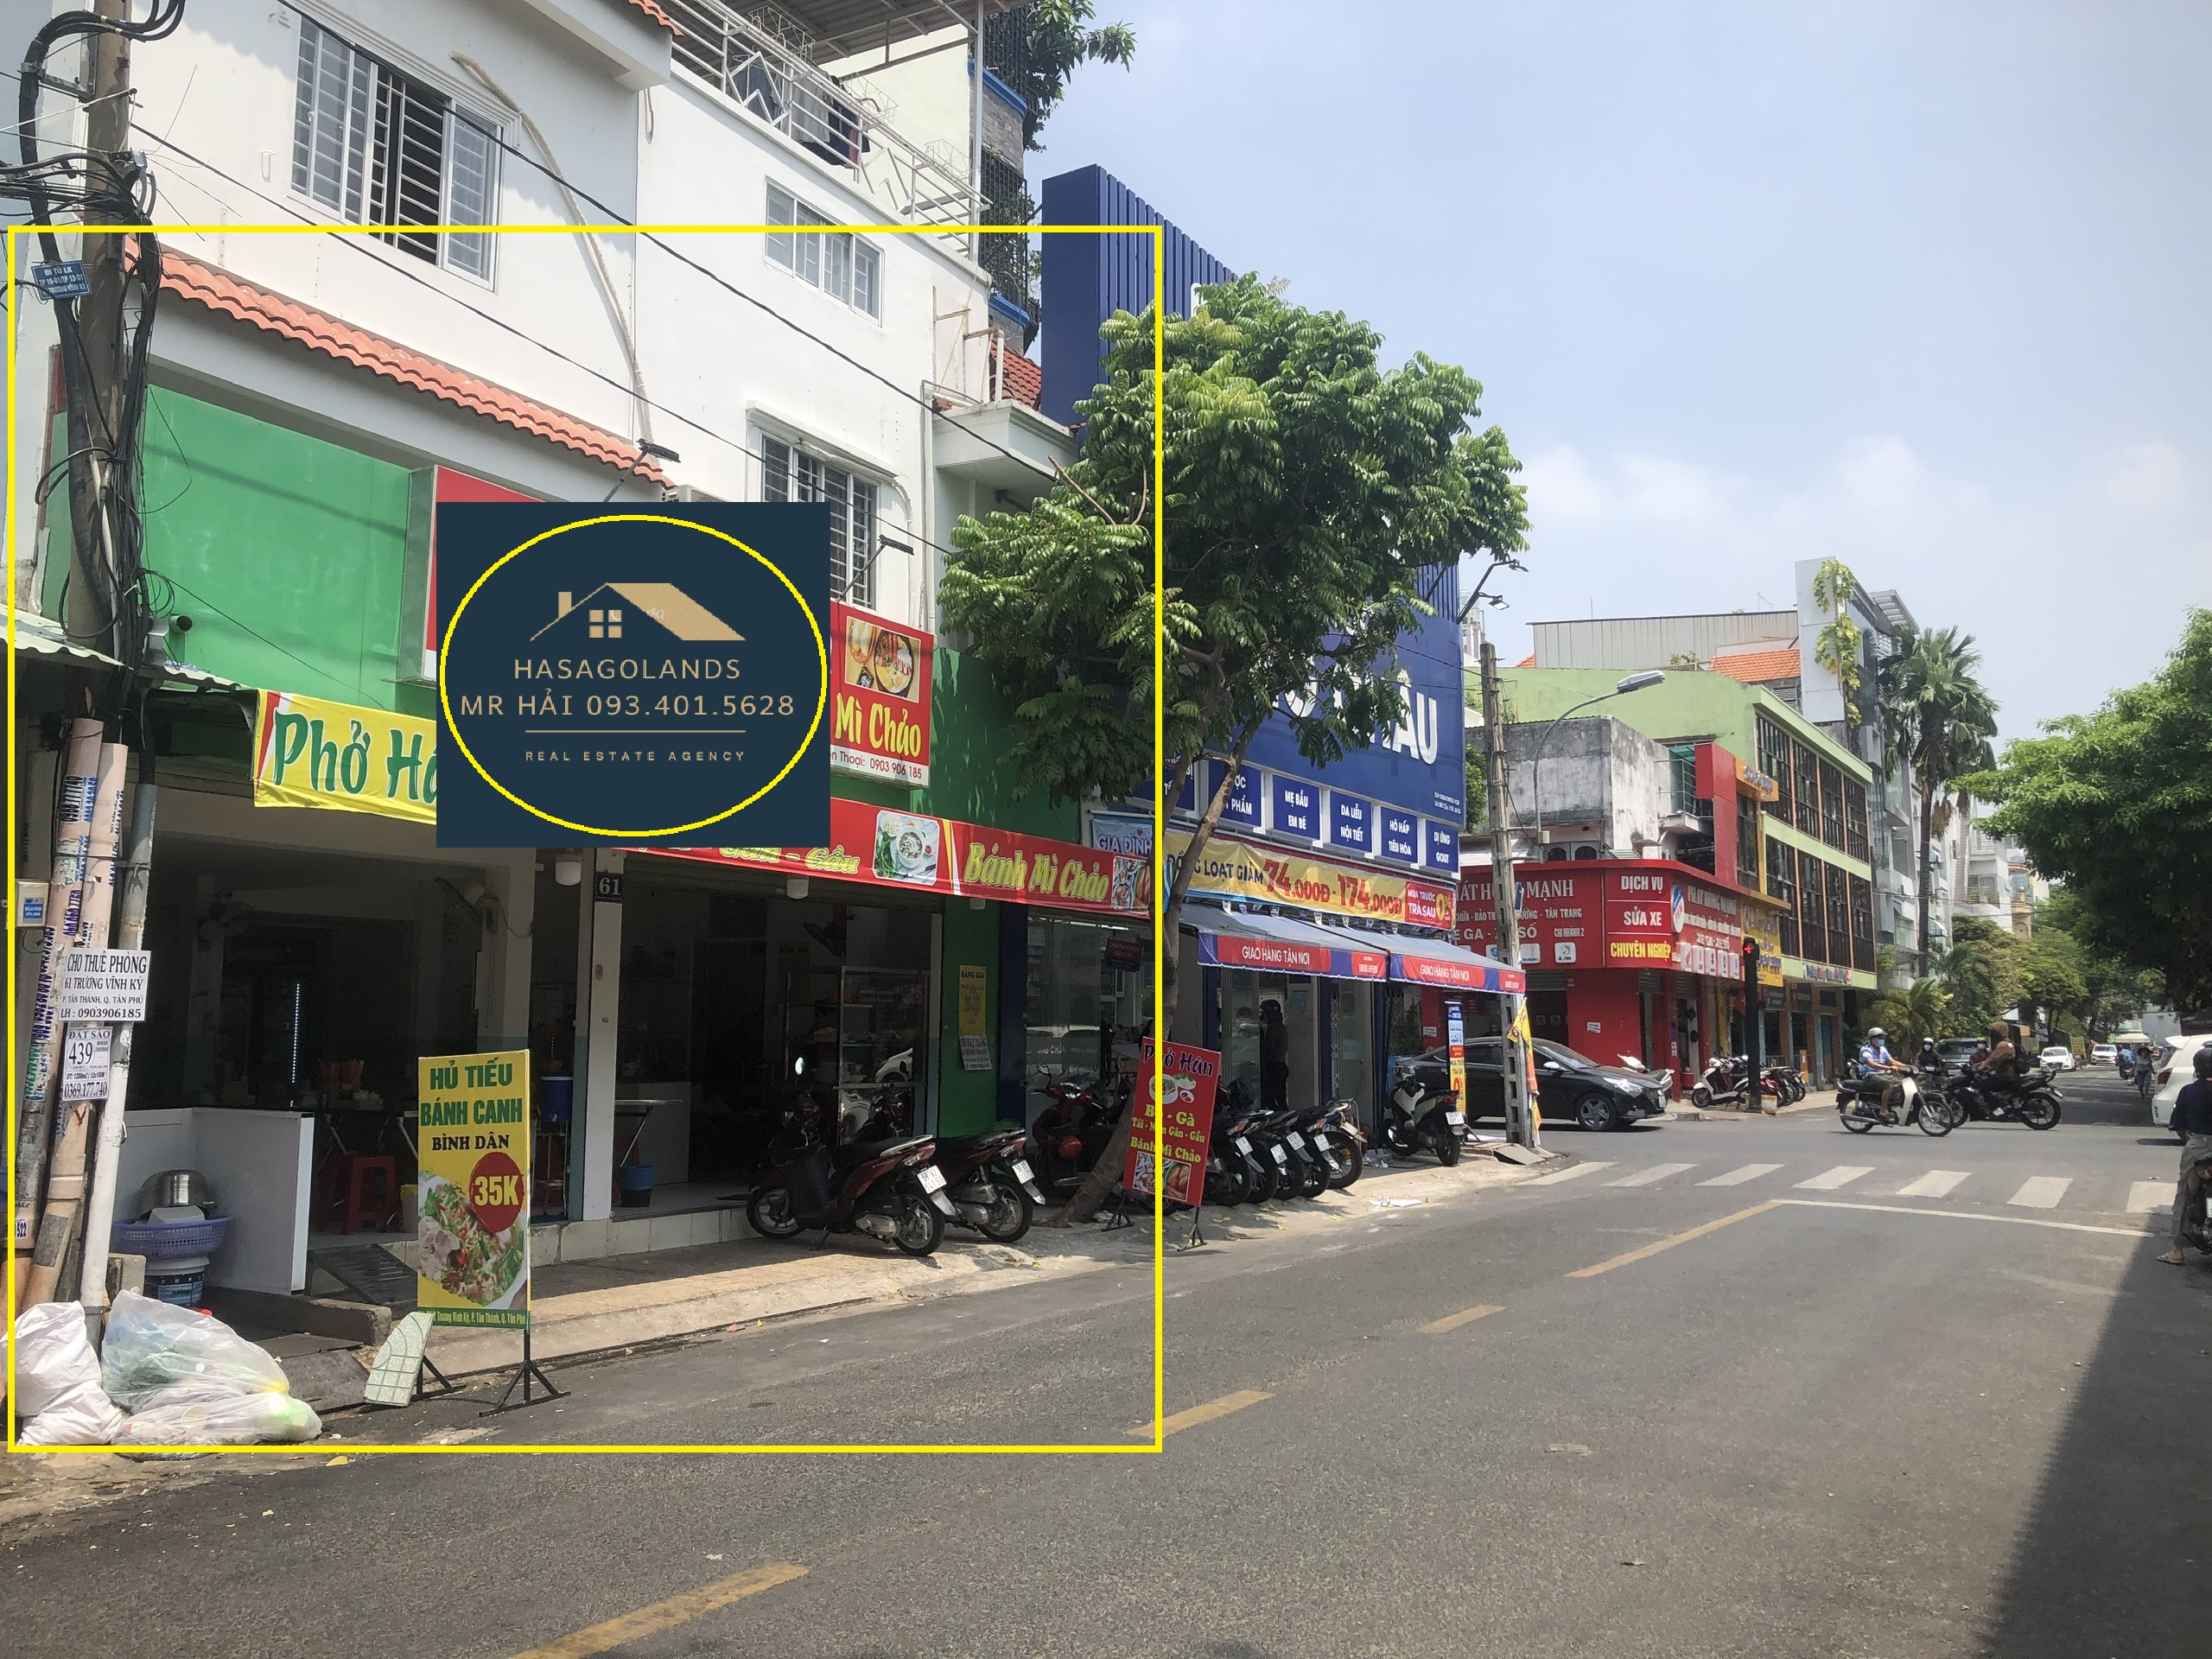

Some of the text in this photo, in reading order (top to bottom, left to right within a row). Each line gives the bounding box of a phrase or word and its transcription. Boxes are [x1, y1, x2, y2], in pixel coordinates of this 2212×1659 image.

[835, 692, 922, 759] Mì Chảo
[273, 707, 372, 795] Phở
[839, 750, 866, 769] Thoại:
[869, 759, 890, 774] 0903
[891, 762, 907, 777] 906
[909, 766, 923, 779] 185
[1230, 795, 1253, 816] PHẨM
[1284, 790, 1294, 808] MẸ
[1340, 804, 1350, 818] DA
[1287, 814, 1306, 830] EM BÉ
[1389, 818, 1410, 835] HÔ HẤP
[1097, 832, 1153, 855] GIA ĐÌNH
[1340, 825, 1363, 842] NỘI TIẾT
[1433, 830, 1440, 846] DỊ
[1388, 839, 1412, 856] TIÊU HÓA
[1435, 850, 1450, 864] GOUT
[804, 843, 861, 874] Gầu
[963, 842, 1109, 902] Bánh Mì Chảo
[1204, 860, 1234, 882] LOẠT
[1236, 861, 1264, 885] GIẢM
[599, 877, 620, 896] 61
[1526, 879, 1574, 902] MẠNH
[1621, 875, 1664, 894] DỊCH VỤ
[1408, 899, 1422, 916] TRẢ
[1421, 905, 1436, 918] SAU
[1474, 908, 1487, 921] BẢO
[1545, 907, 1558, 919] TÂN
[1559, 908, 1583, 919] TRANG
[1624, 906, 1662, 926] SỬA XE
[1464, 928, 1484, 940] GA
[1518, 922, 1537, 939] SỐ
[1242, 946, 1310, 966] GIAO HÀNG TẬN NƠI
[1610, 939, 1671, 962] CHUYÊN NGHIỆP
[67, 950, 147, 974] CHO THUÊ PHÒNG
[1420, 963, 1433, 976] GIAO
[1434, 964, 1449, 979] HÀNG
[1450, 965, 1461, 982] TẬN
[64, 976, 72, 989] 61
[105, 976, 127, 990] VĨNH
[129, 976, 144, 990] KÝ
[67, 994, 79, 1003] TÂN
[103, 995, 111, 1005] Q.
[112, 995, 127, 1004] TÂN
[128, 995, 143, 1004] PHÚ
[60, 1007, 142, 1019] LH 0903906185
[68, 1042, 93, 1065] 439
[429, 1057, 513, 1090] HỦ TIẾU
[1179, 1051, 1214, 1077] Hân
[420, 1096, 523, 1127] BÁNH CANH
[1176, 1111, 1195, 1127] Gà
[431, 1131, 511, 1152] BÌNH DÂN
[1168, 1126, 1184, 1138] Gân
[1190, 1129, 1205, 1143] Gầu
[1130, 1136, 1157, 1154] Bánh
[1174, 1147, 1201, 1164] Chảo
[474, 1175, 519, 1206] 35K
